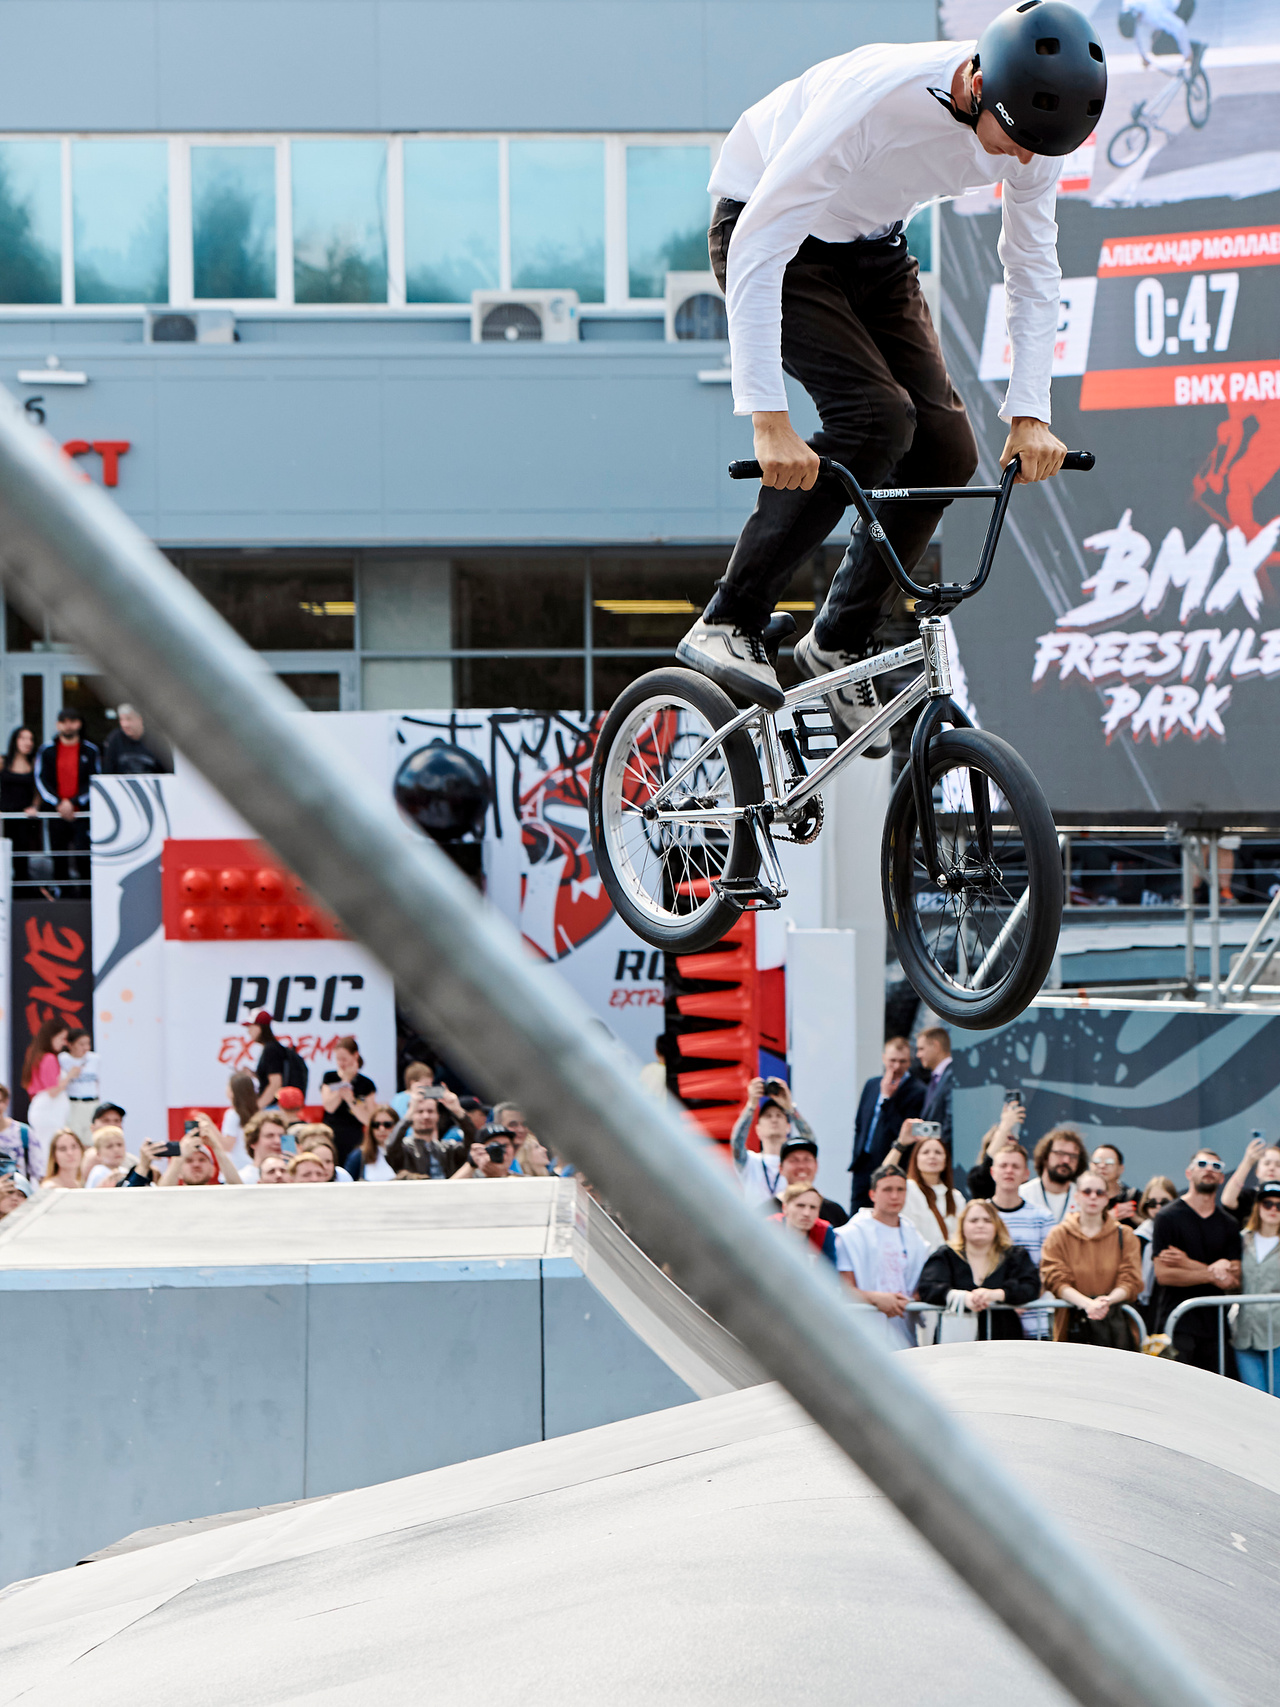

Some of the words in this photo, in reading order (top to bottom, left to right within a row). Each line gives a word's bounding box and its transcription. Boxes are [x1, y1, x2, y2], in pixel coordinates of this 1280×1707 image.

[1098, 239, 1202, 268] АЛЕКСАНДР
[1134, 272, 1240, 358] 0:47
[1174, 373, 1227, 406] BMX
[871, 488, 910, 499] REDBMX
[1100, 682, 1234, 739] PARK
